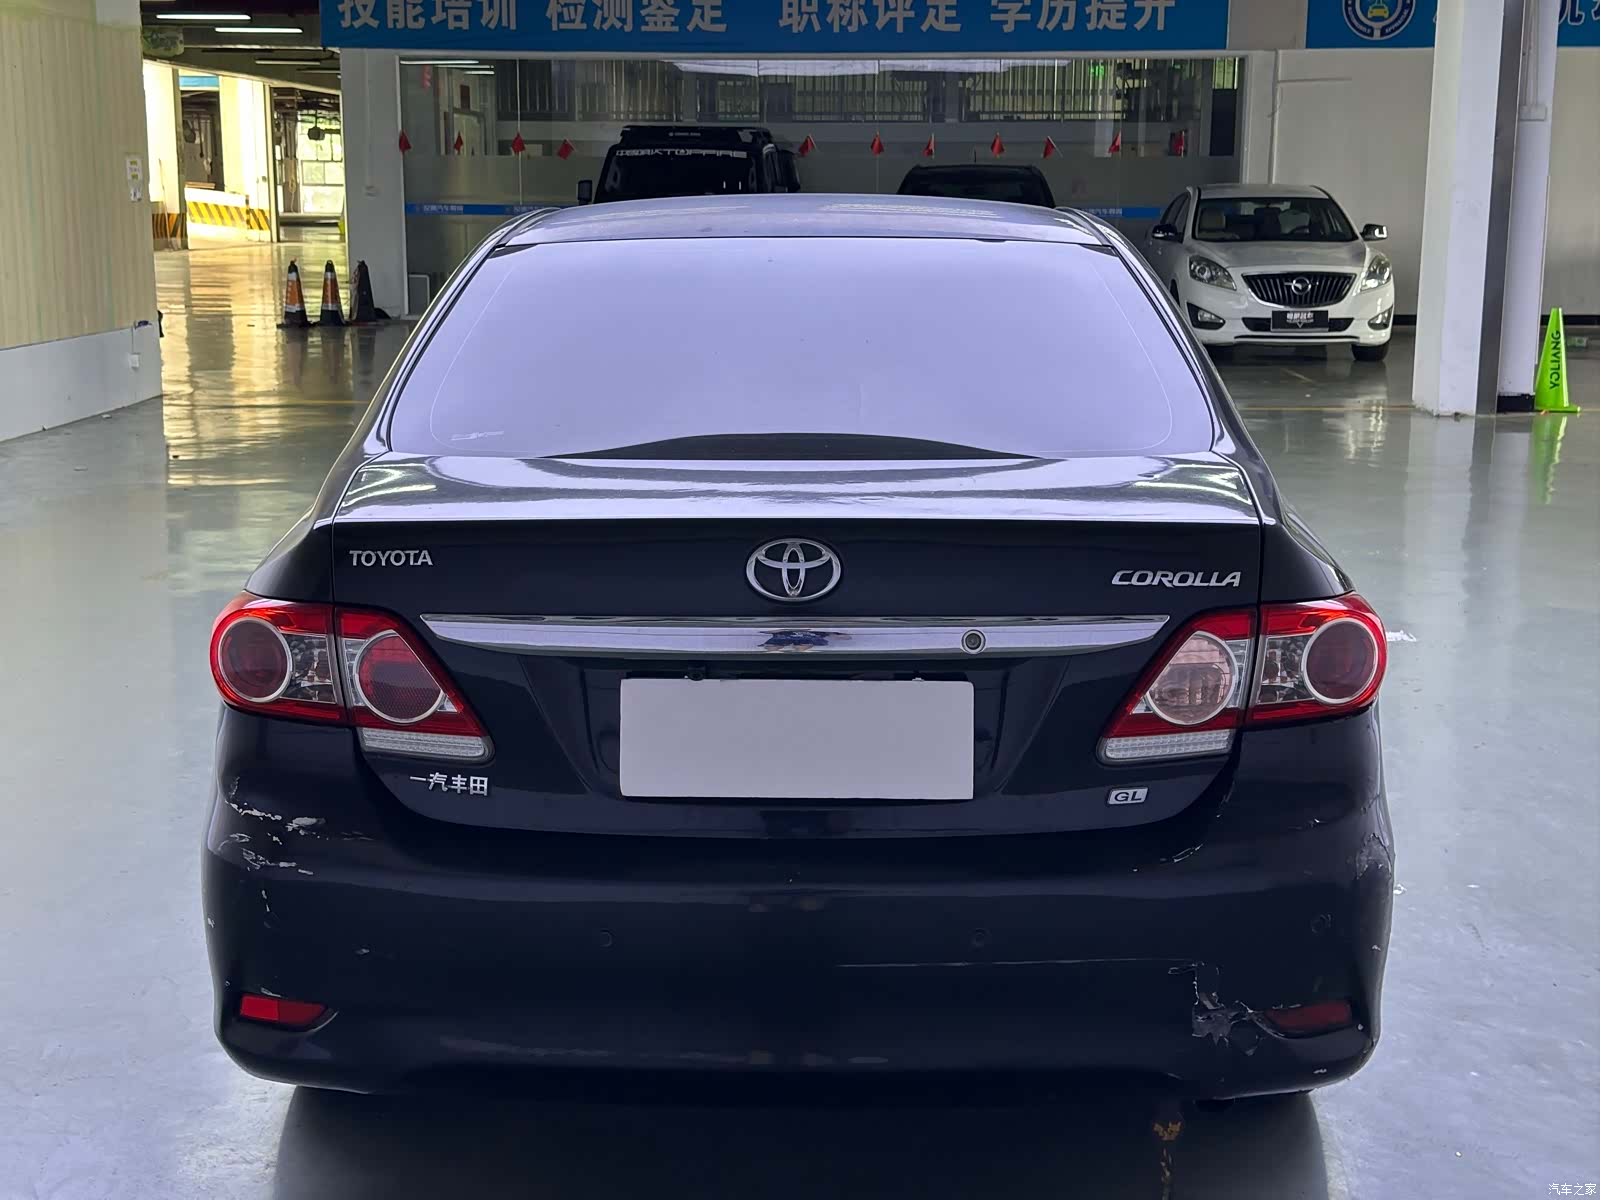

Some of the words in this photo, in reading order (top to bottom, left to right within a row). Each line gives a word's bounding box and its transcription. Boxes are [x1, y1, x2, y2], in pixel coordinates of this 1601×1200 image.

[338, 0, 517, 31] 技能培训
[545, 0, 728, 32] 检测鉴定
[779, 0, 962, 33] 职称评定
[990, 0, 1176, 32] 学历提升
[349, 549, 434, 567] TOYOTA
[1111, 570, 1242, 588] COROLLA
[409, 771, 488, 796] 一汽丰田
[1114, 790, 1143, 802] GL
